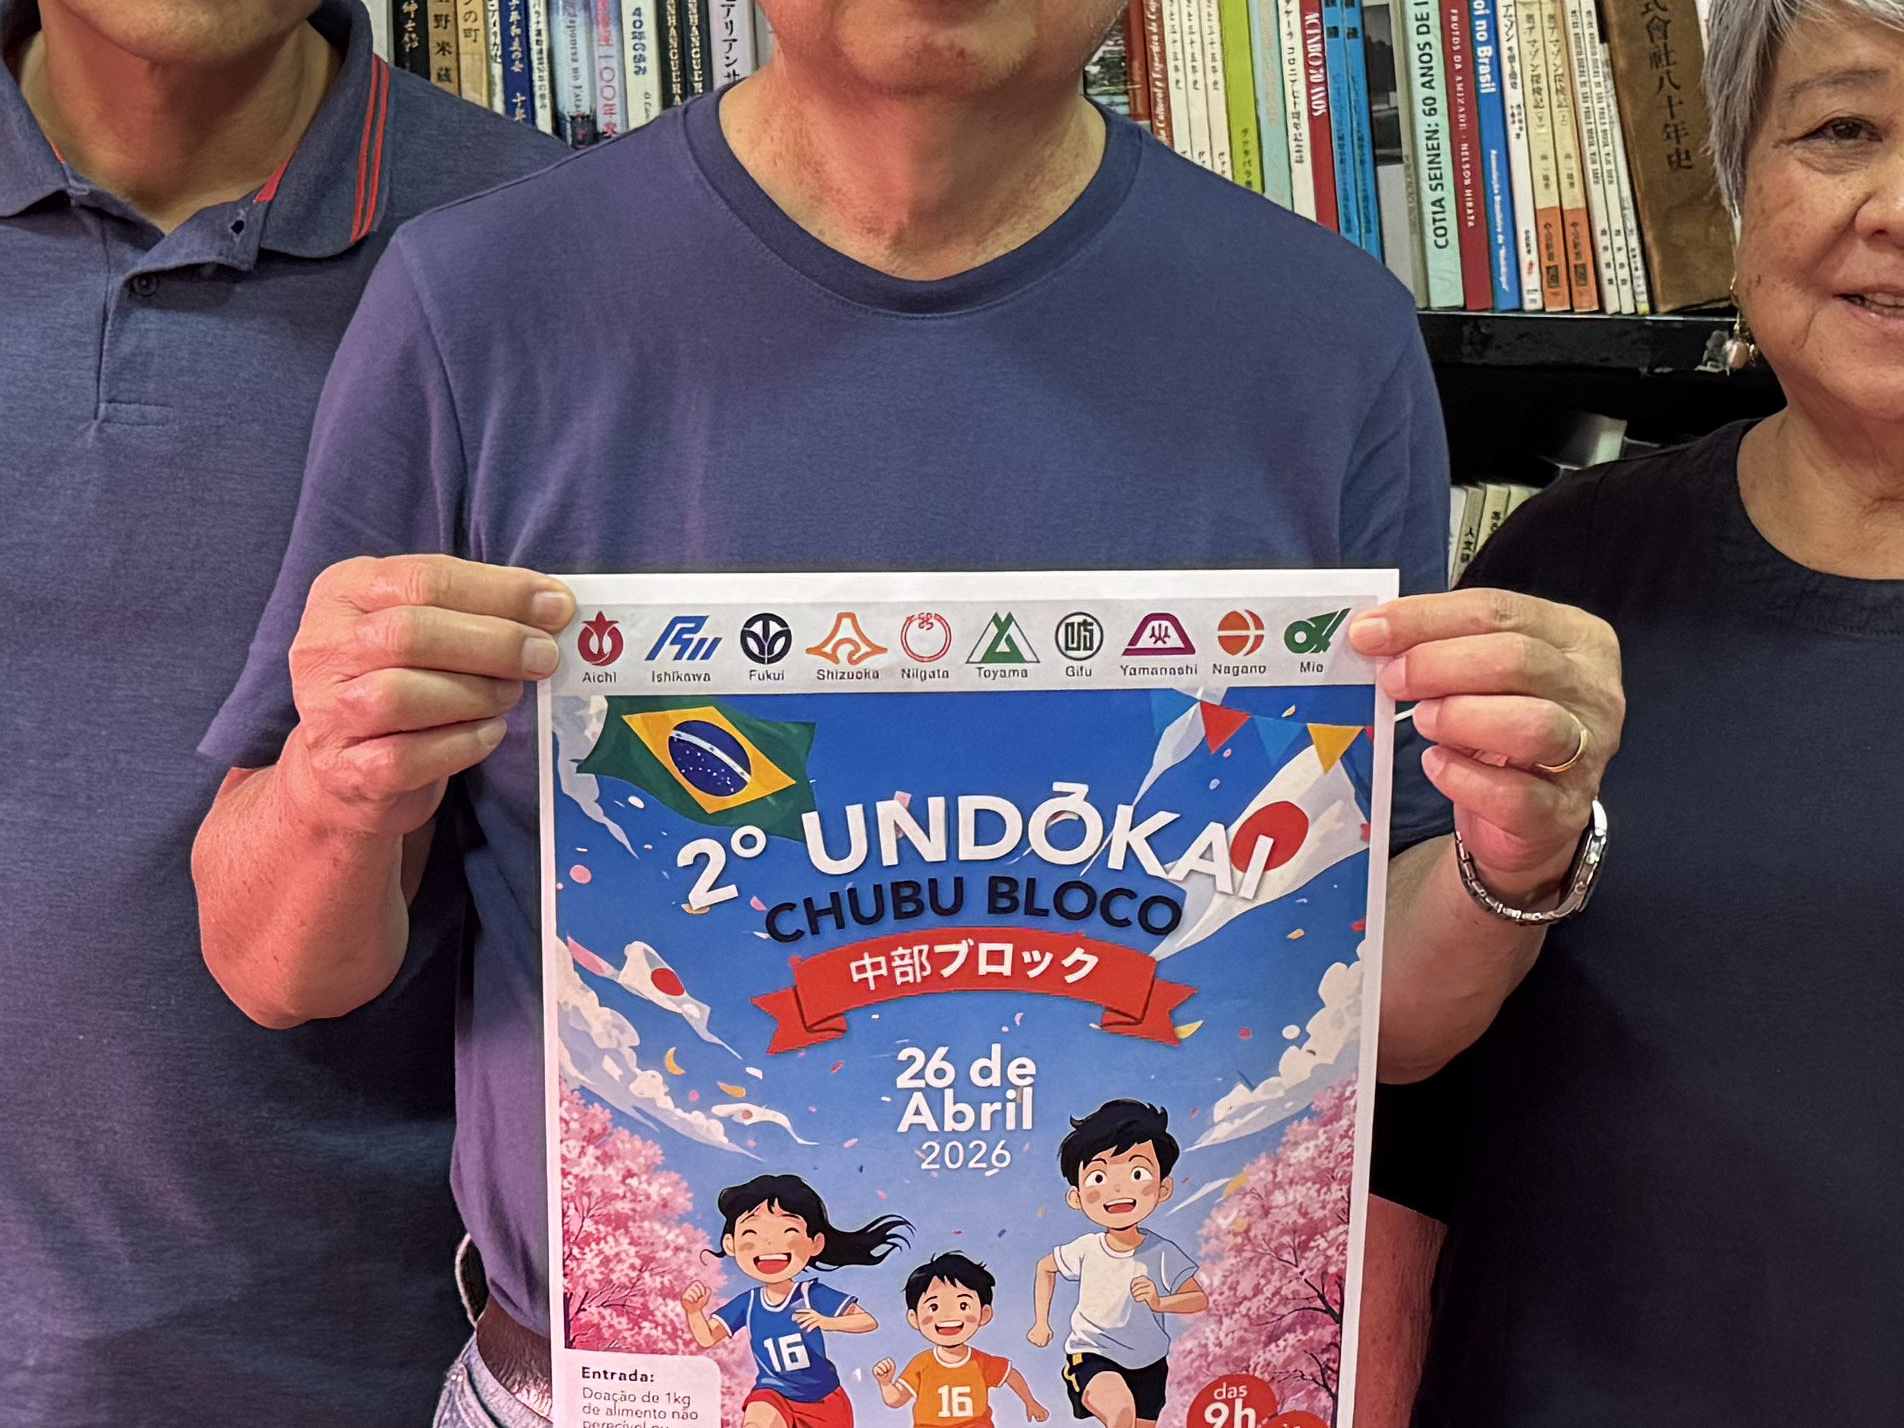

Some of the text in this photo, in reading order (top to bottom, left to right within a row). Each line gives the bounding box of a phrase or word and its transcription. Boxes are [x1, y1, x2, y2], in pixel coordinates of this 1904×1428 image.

[1414, 12, 1430, 36] DE
[1475, 19, 1489, 41] no
[1416, 41, 1436, 91] ANOS
[1479, 45, 1497, 93] Brasil
[1421, 96, 1437, 118] 60
[1449, 8, 1476, 228] FRUTOS DA NELSON HIRATA
[1425, 122, 1444, 193] SEINEN:
[1430, 197, 1449, 250] COTIA
[582, 671, 617, 683] Aichi
[651, 670, 711, 683] Ishikawa
[749, 670, 785, 681] Fukui
[816, 668, 879, 681] Shizuoka
[900, 668, 949, 682] Niigata
[976, 666, 1029, 679] Toyama
[1065, 665, 1092, 677] Gifu
[1120, 663, 1198, 677] Yamanashi
[1212, 663, 1267, 676] Nagano
[800, 782, 1276, 901] UNDŌKAI
[765, 876, 1182, 943] CHUBU BLOCO
[850, 941, 1102, 988] 中部ブロック
[896, 1043, 1037, 1088] 26 de
[897, 1087, 1033, 1132] Abril
[921, 1140, 1012, 1170] 2026
[764, 1333, 810, 1372] 16
[582, 1366, 654, 1383] Entrada:
[583, 1387, 691, 1409] Doação de 1kg
[937, 1385, 973, 1418] 16
[1213, 1382, 1248, 1401] das
[582, 1401, 698, 1420] de alimento não
